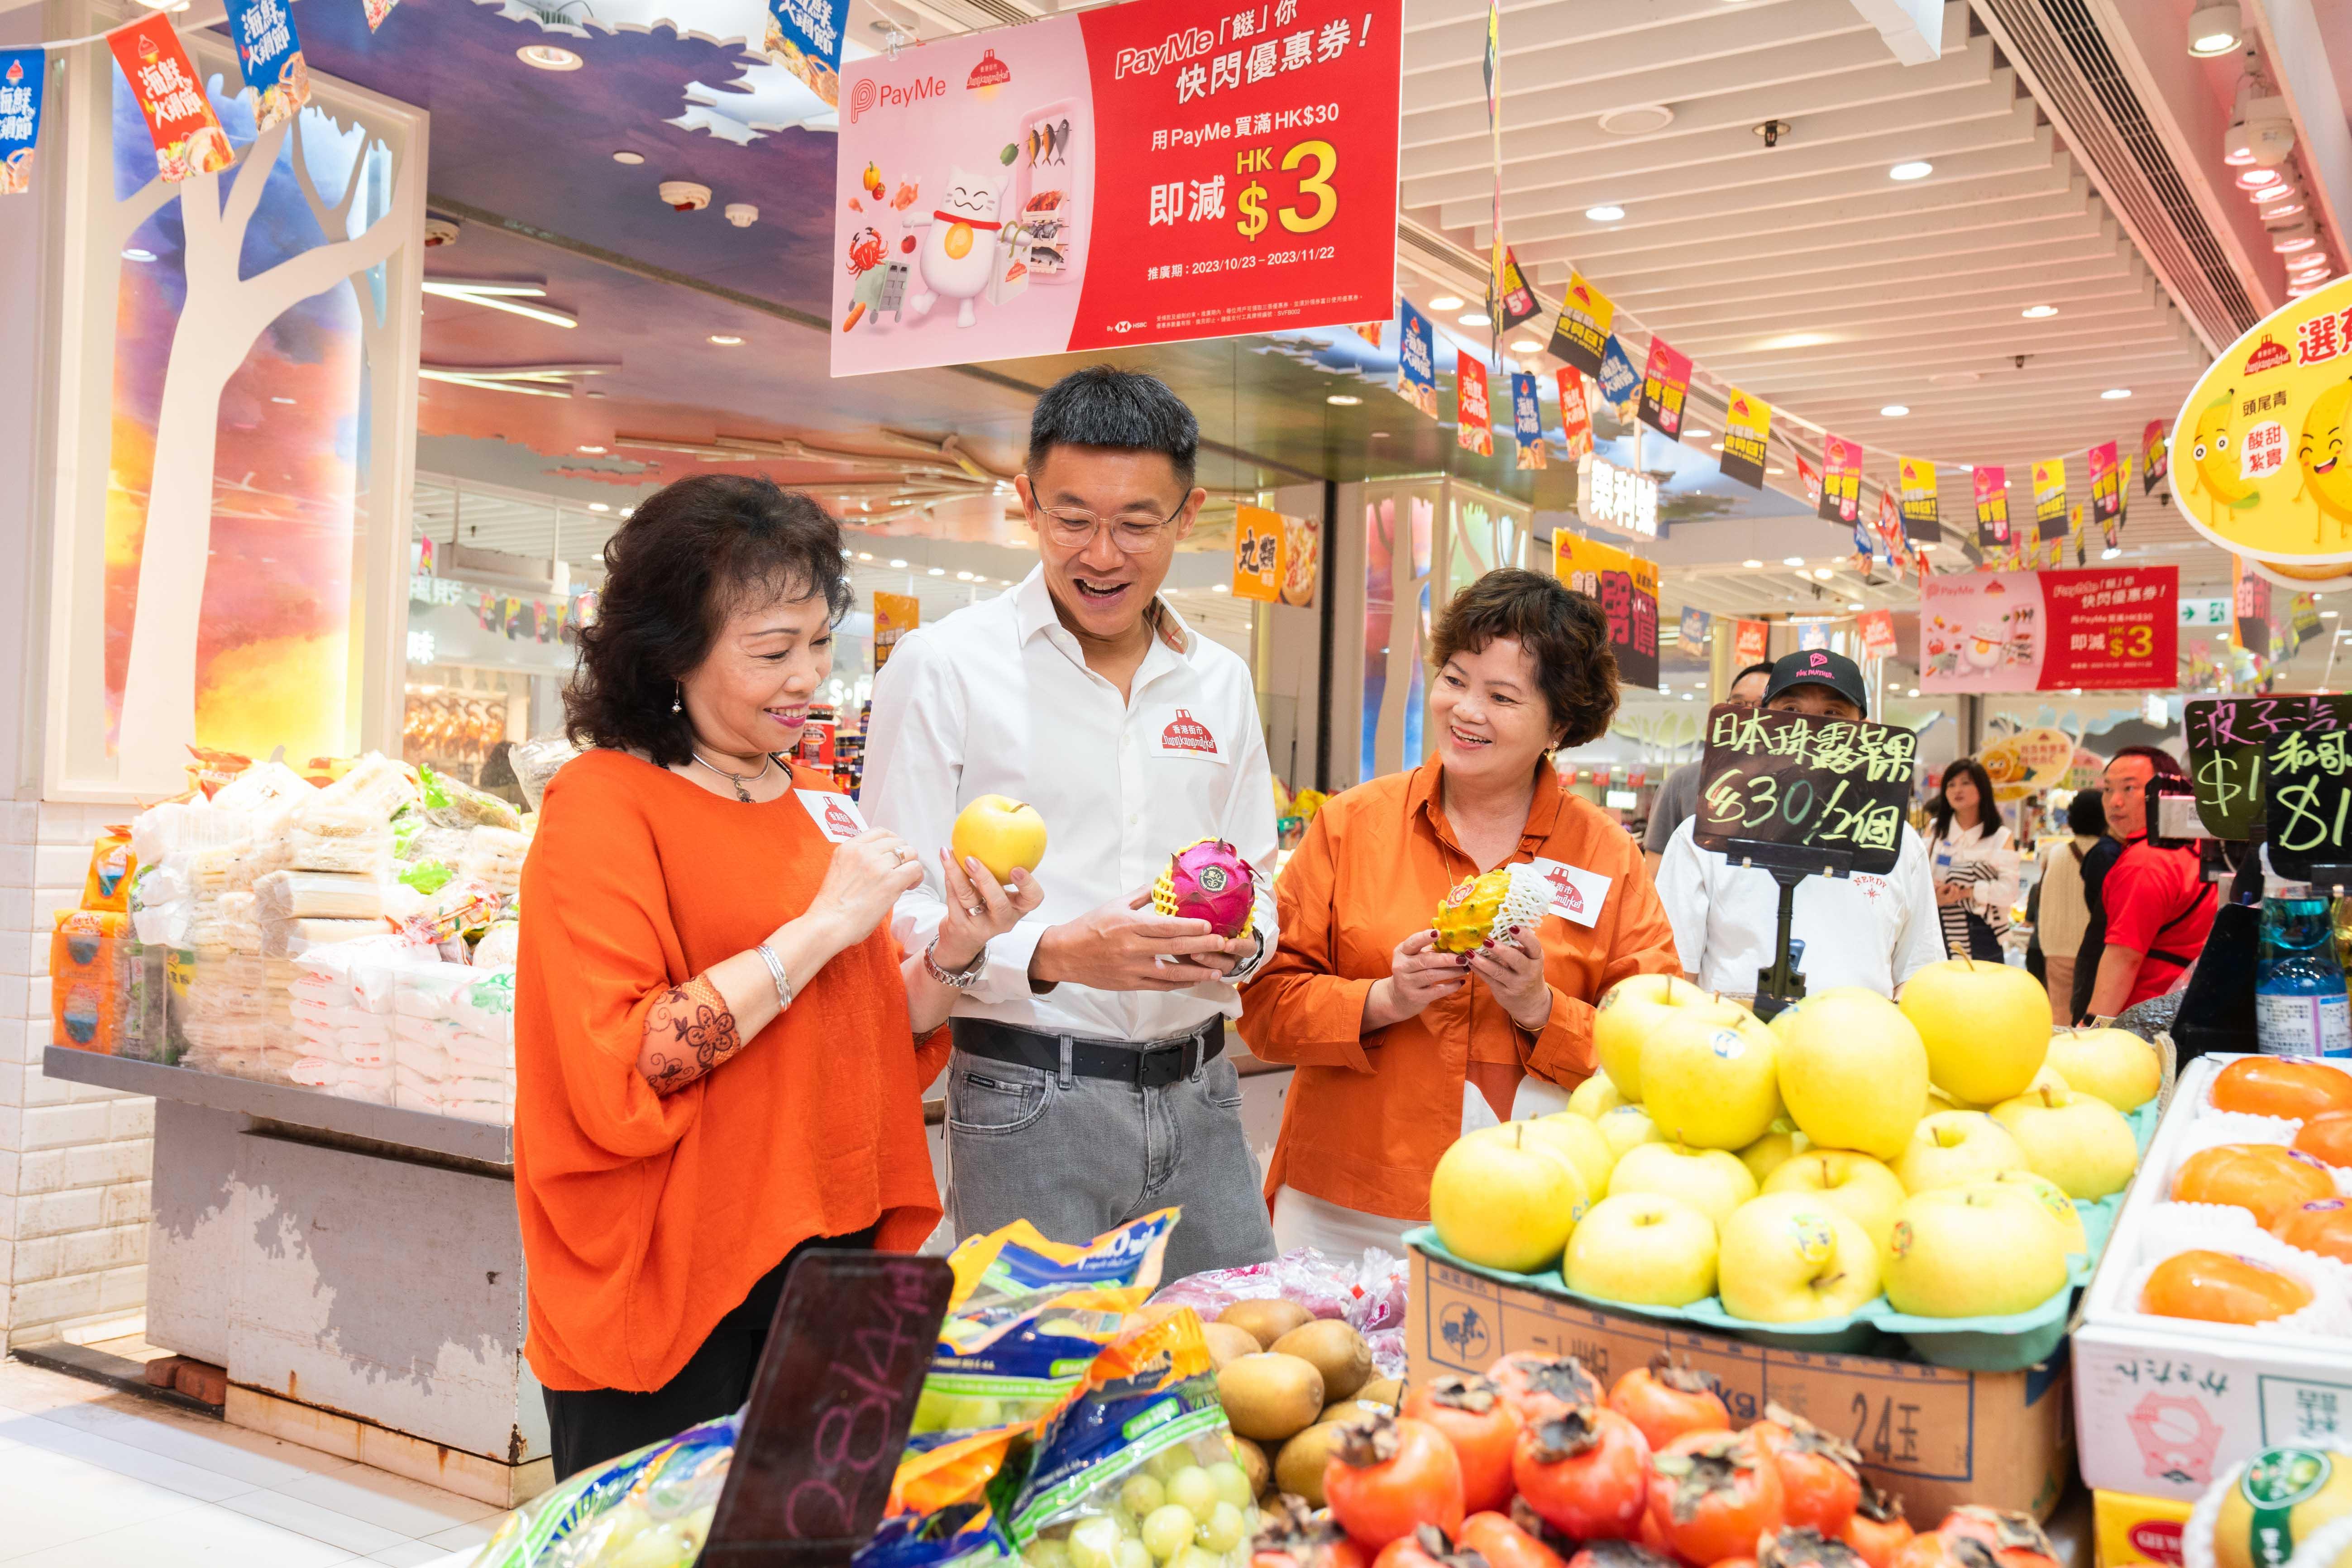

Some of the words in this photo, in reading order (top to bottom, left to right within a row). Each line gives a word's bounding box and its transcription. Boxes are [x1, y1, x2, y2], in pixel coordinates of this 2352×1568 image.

[138, 57, 186, 99] 海鮮
[880, 76, 946, 108] PayMe
[153, 87, 203, 129] 火鍋節
[0, 115, 33, 140] 鍋節
[1149, 175, 1225, 226] 即減
[1237, 147, 1273, 174] HK
[2299, 307, 2352, 365] 選
[2243, 390, 2287, 417] 頭尾青
[2248, 425, 2282, 449] 酸甜
[2249, 448, 2283, 473] 紮實
[1172, 725, 1203, 735] 香港街市
[2194, 697, 2352, 748] 波子汽
[1853, 876, 1887, 888] NERDY
